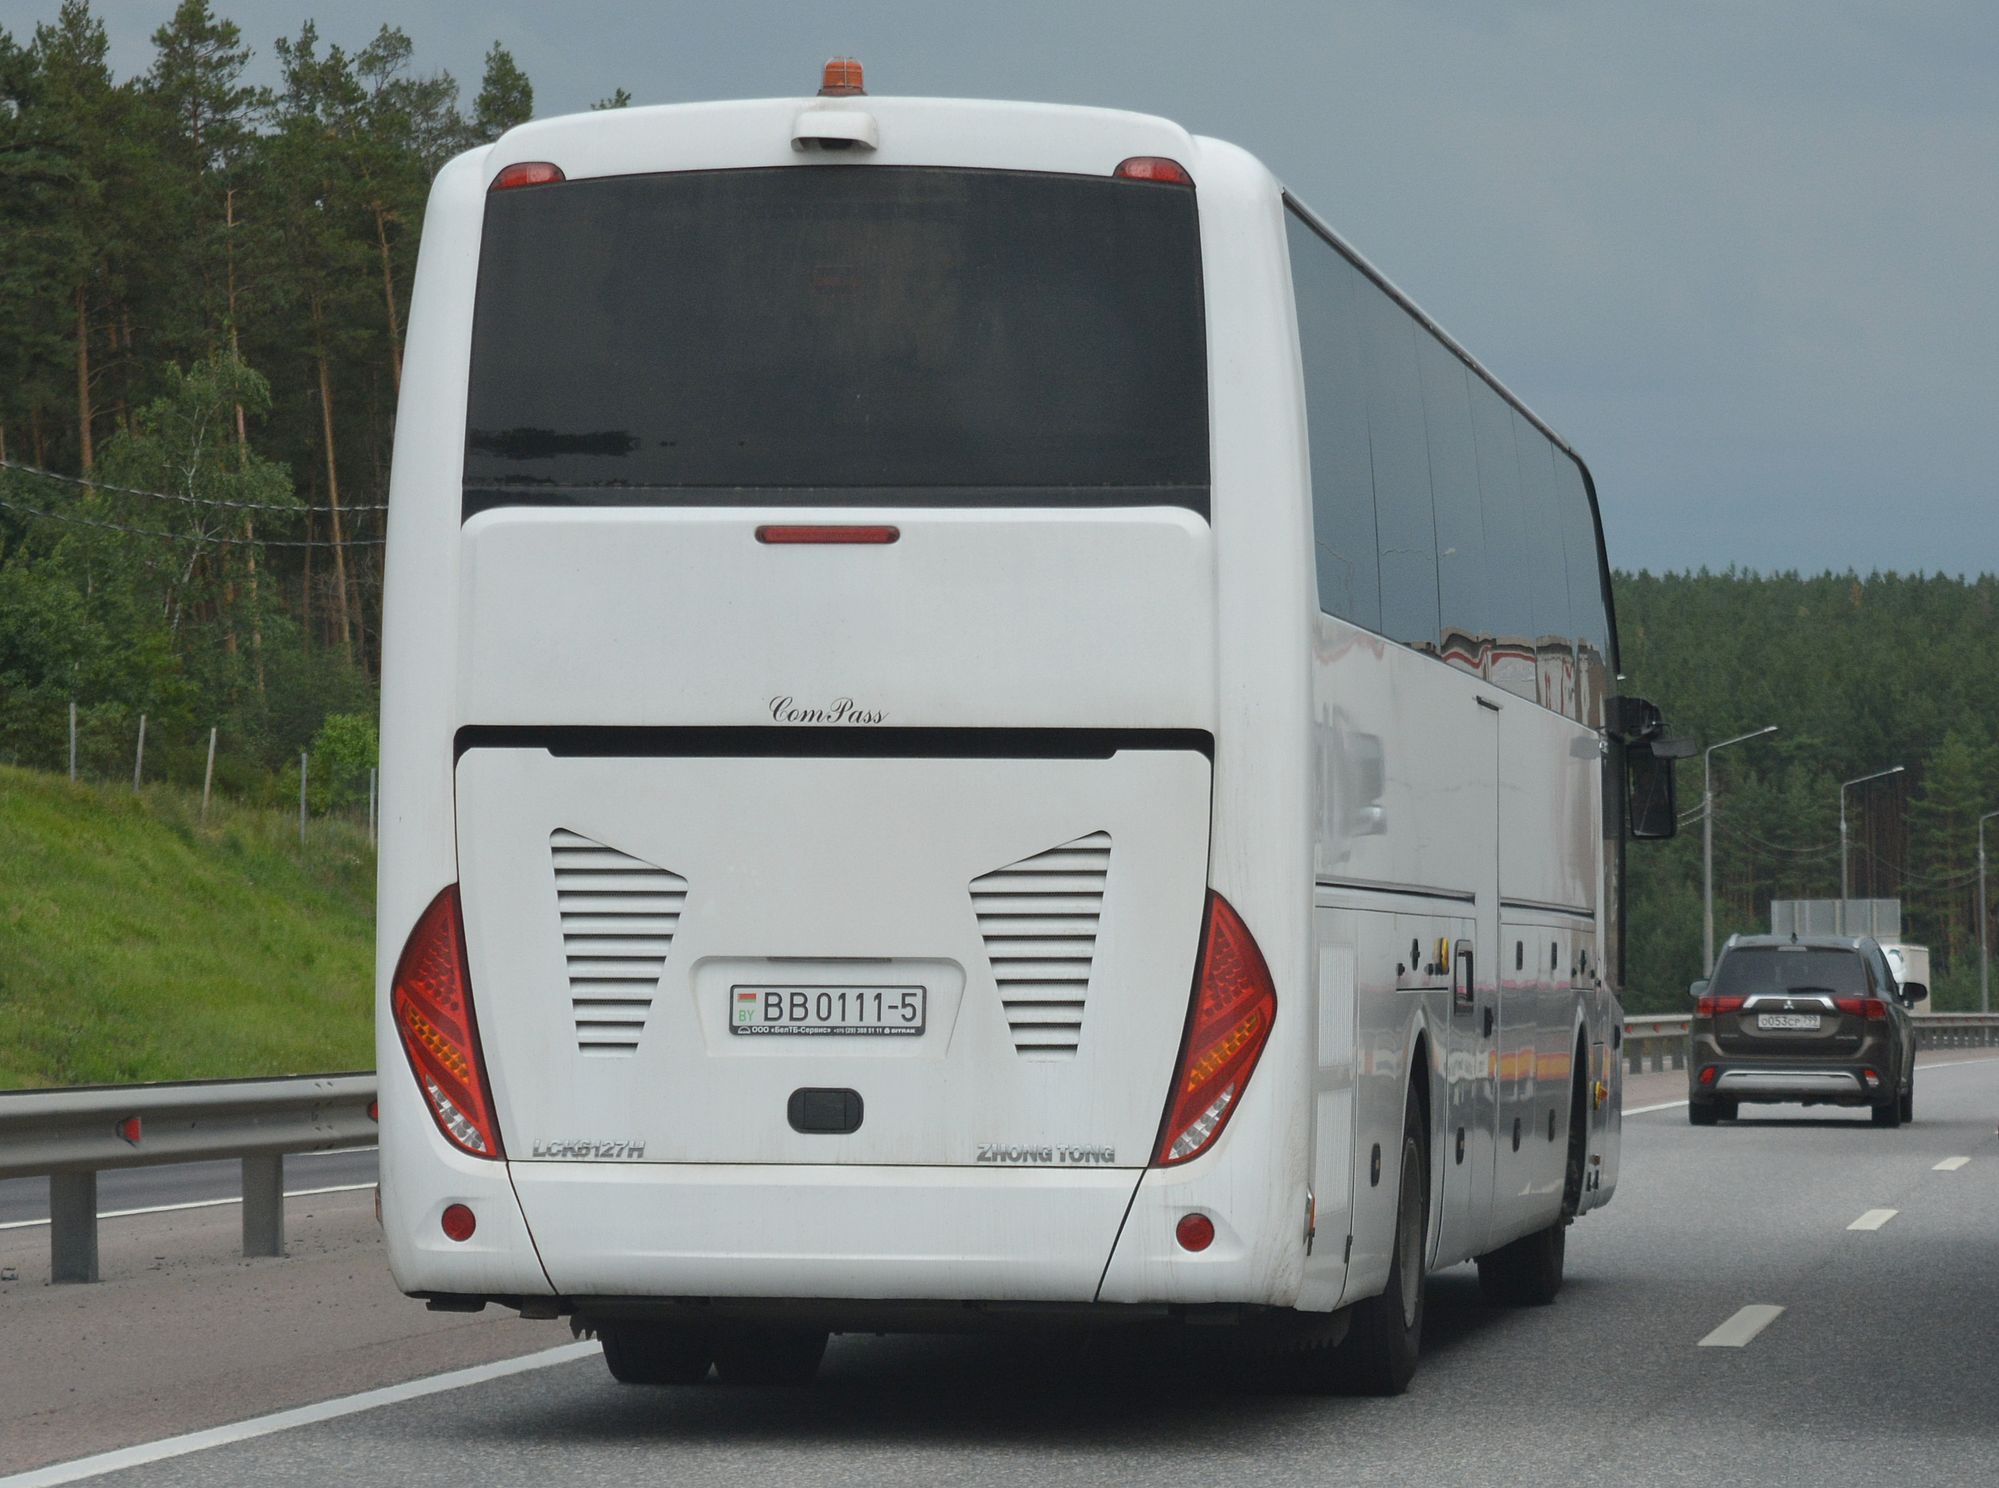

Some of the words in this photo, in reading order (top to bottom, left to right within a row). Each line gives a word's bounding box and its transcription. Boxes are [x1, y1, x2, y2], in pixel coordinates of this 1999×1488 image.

[769, 696, 889, 724] ComPass
[738, 1009, 755, 1022] BY
[976, 1143, 1053, 1163] ZHONG
[1056, 1143, 1116, 1163] TONG
